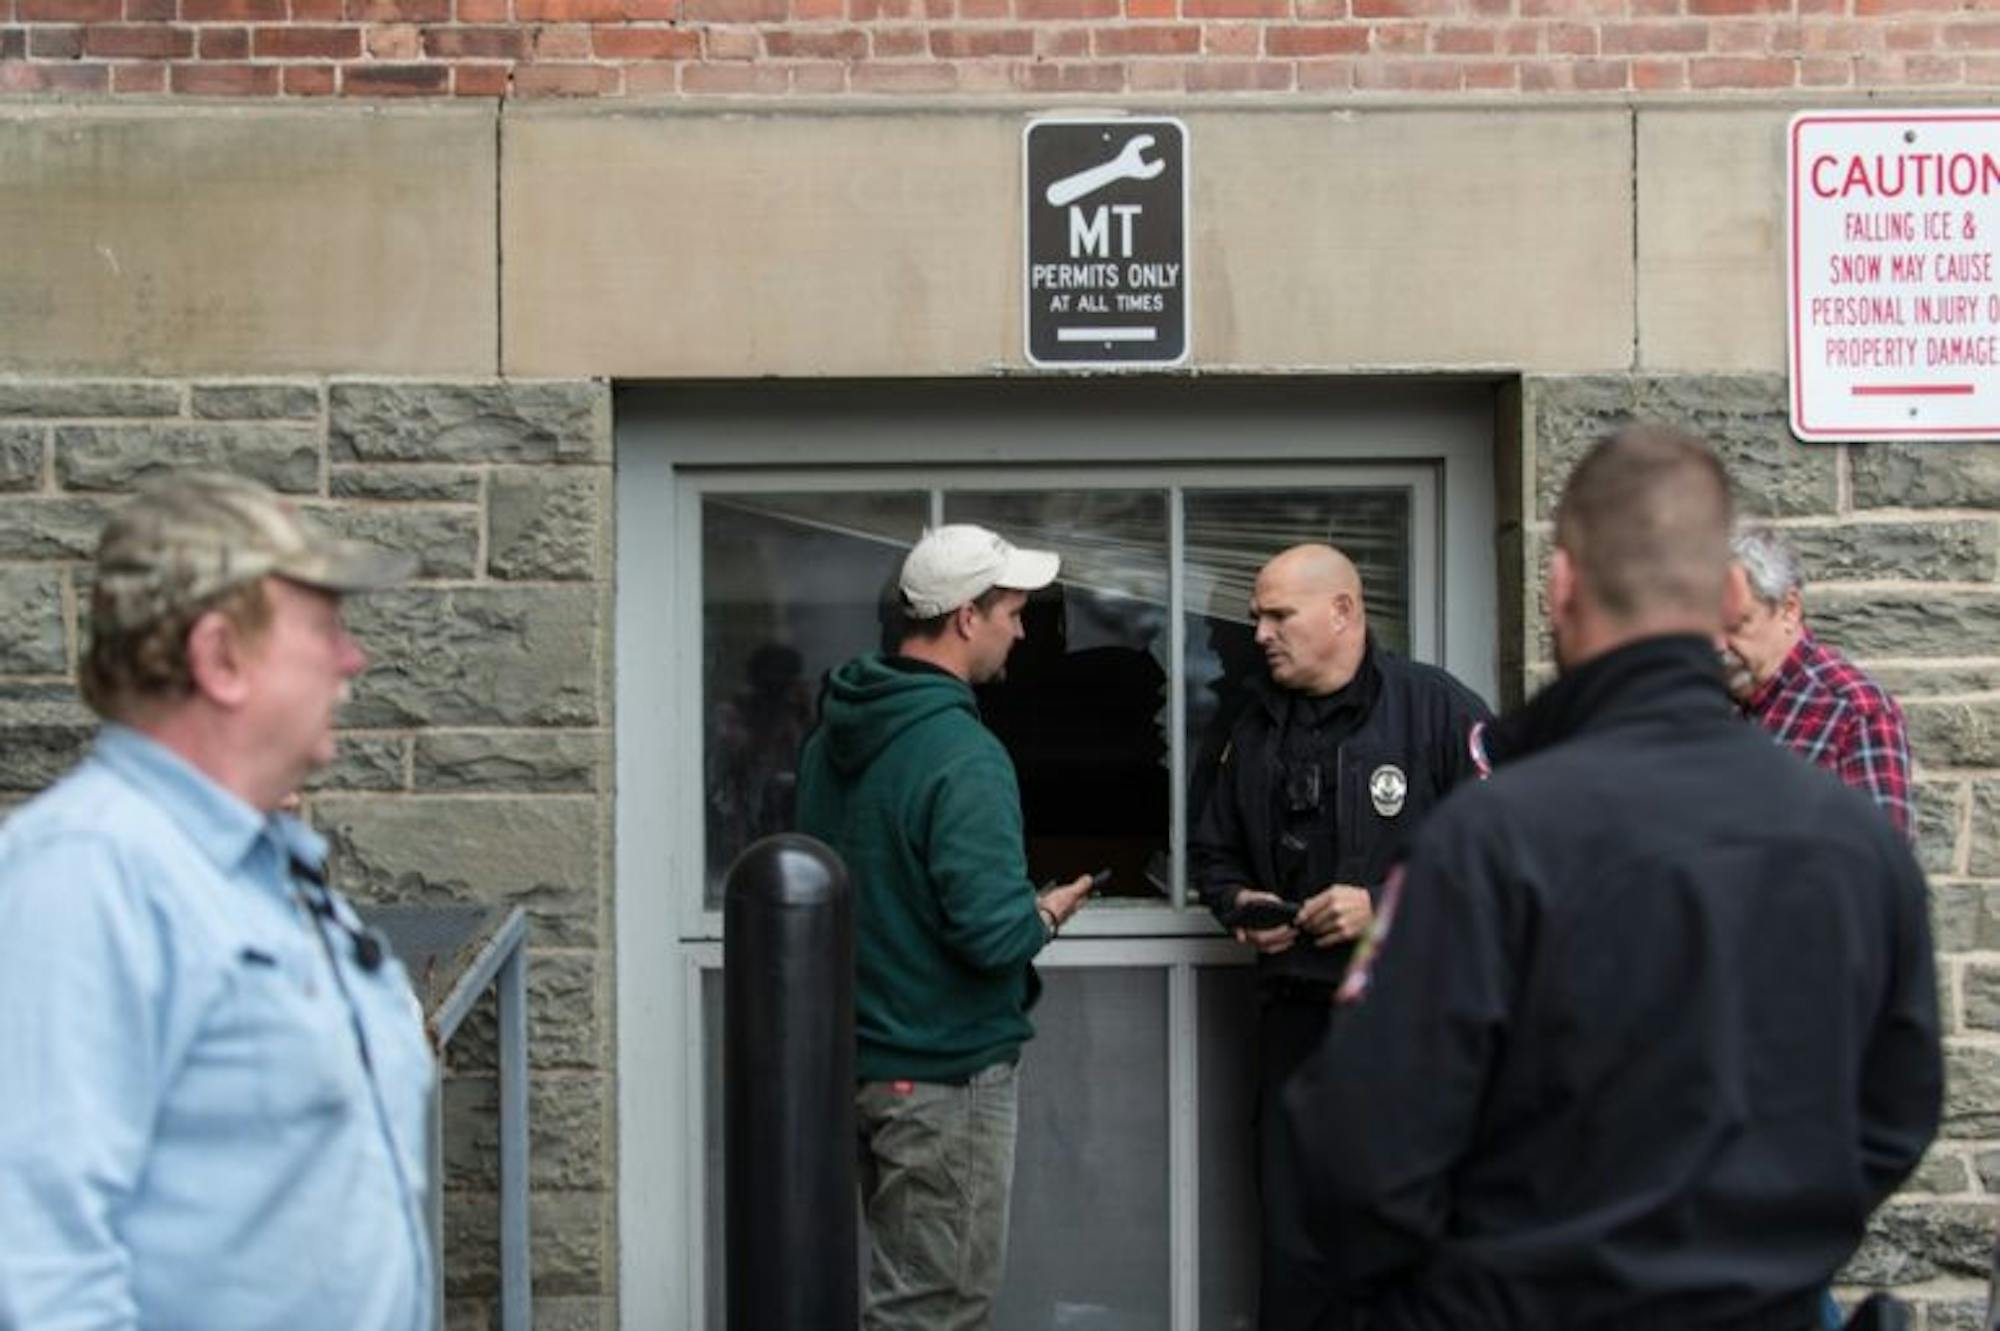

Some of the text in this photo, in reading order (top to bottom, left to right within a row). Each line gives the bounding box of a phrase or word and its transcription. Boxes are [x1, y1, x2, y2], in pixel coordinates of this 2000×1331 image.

[1811, 153, 2000, 199] CAUTION
[1069, 204, 1143, 258] MT
[1846, 211, 1976, 240] FALLING ICE &
[1032, 264, 1180, 289] PERMITS ONLY
[1830, 253, 1993, 285] SNOW MAY CAUSE
[1050, 295, 1163, 313] AT ALL TIMES
[1812, 294, 2000, 326] PERSONAL INJURY O
[1826, 336, 2000, 367] PROPERTY DAMAGE
